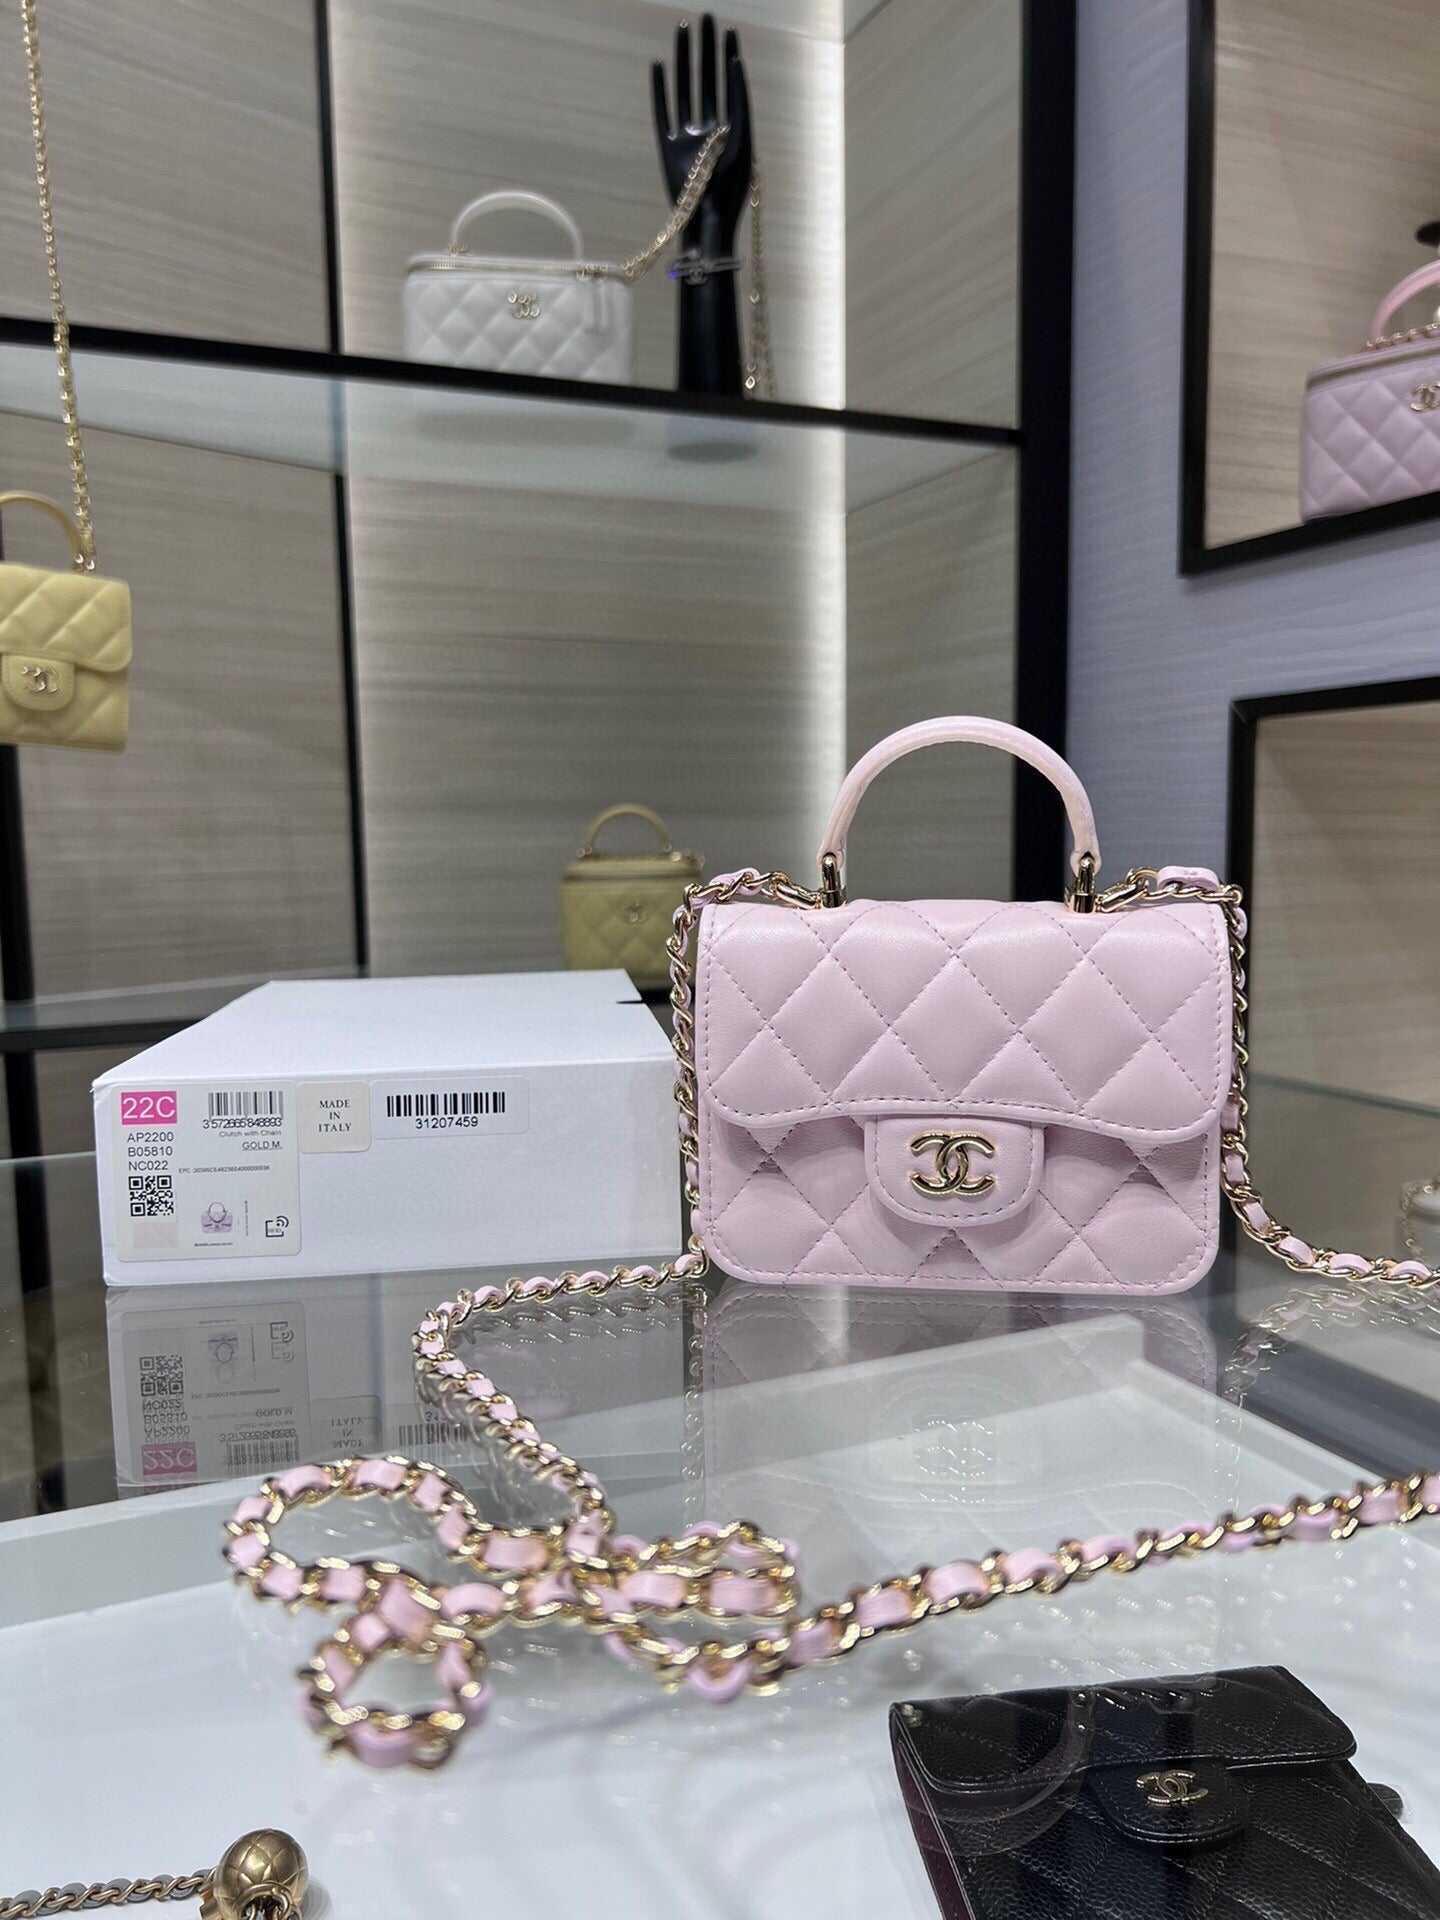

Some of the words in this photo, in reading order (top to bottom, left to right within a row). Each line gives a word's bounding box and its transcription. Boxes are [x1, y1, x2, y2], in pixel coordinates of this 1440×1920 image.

[122, 1095, 176, 1119] 22C
[319, 1099, 351, 1109] MADE
[329, 1111, 341, 1120] IN
[318, 1123, 352, 1133] ITALY
[415, 1116, 479, 1130] 31207459
[127, 1131, 174, 1143] AP2200
[219, 1130, 243, 1138] Clutch
[244, 1129, 259, 1137] with
[260, 1129, 282, 1137] Chain
[242, 1140, 270, 1150] GOLD
[128, 1146, 173, 1157] B05810
[128, 1160, 169, 1172] NC022
